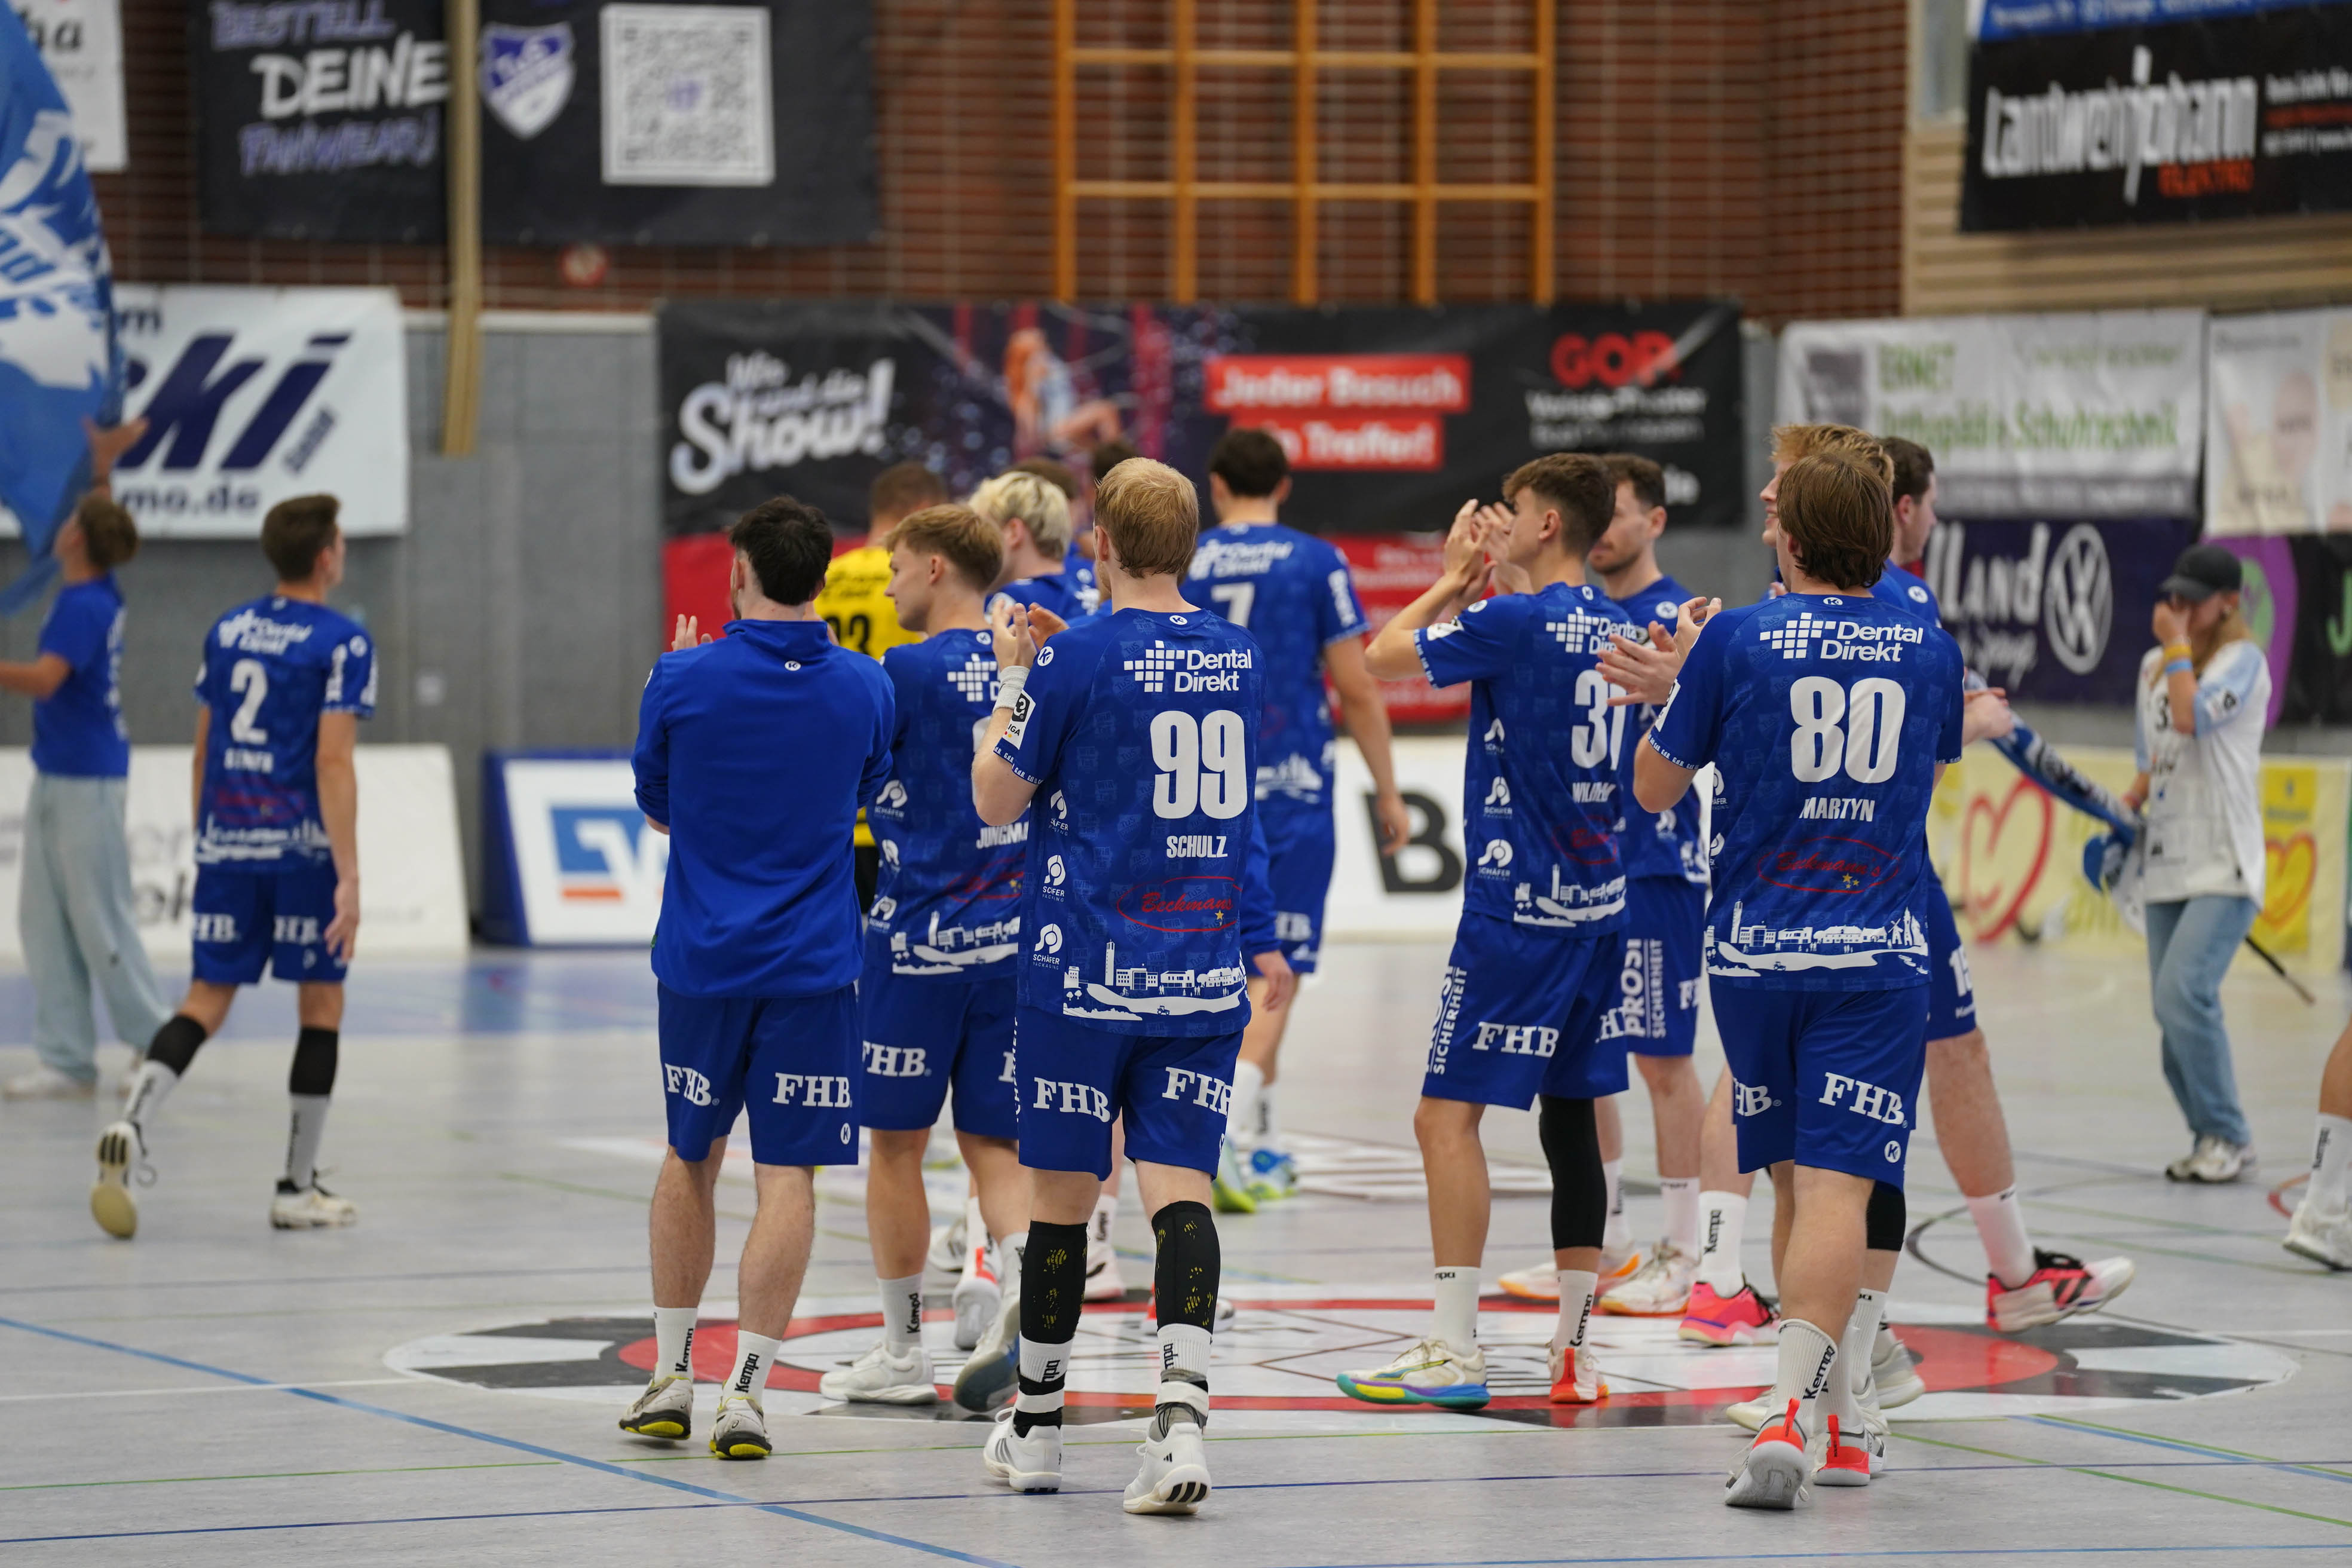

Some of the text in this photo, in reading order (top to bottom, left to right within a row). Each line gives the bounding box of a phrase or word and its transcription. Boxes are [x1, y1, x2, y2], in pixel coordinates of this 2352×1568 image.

[249, 30, 451, 118] DEINE
[1215, 365, 1463, 408] Jeder Besuch
[669, 358, 896, 495] Show!
[1597, 617, 1637, 638] Denta
[1838, 621, 1924, 644] Dental
[1187, 648, 1252, 670] Dental
[1820, 639, 1903, 663] Direkt
[229, 658, 269, 745] 2
[1175, 669, 1240, 693] Direkt
[1007, 724, 1021, 737] IGA
[1790, 676, 1906, 784] 80
[1150, 710, 1248, 819] 99
[1799, 798, 1875, 822] MARTYN
[1166, 835, 1229, 859] SCHULZ
[1033, 954, 1060, 965] SCHÄFER
[1433, 966, 1468, 1076] SICHERHEIT
[1472, 1021, 1560, 1058] FHB
[664, 1062, 712, 1107] FHB
[772, 1072, 851, 1108] FHB
[1033, 1077, 1111, 1123] FHB
[1734, 1077, 1772, 1117] HB
[1818, 1071, 1905, 1126] FHB
[1703, 1209, 1725, 1255] Kempa
[734, 1353, 760, 1394] Kempa
[1802, 1345, 1836, 1400] Kempa
